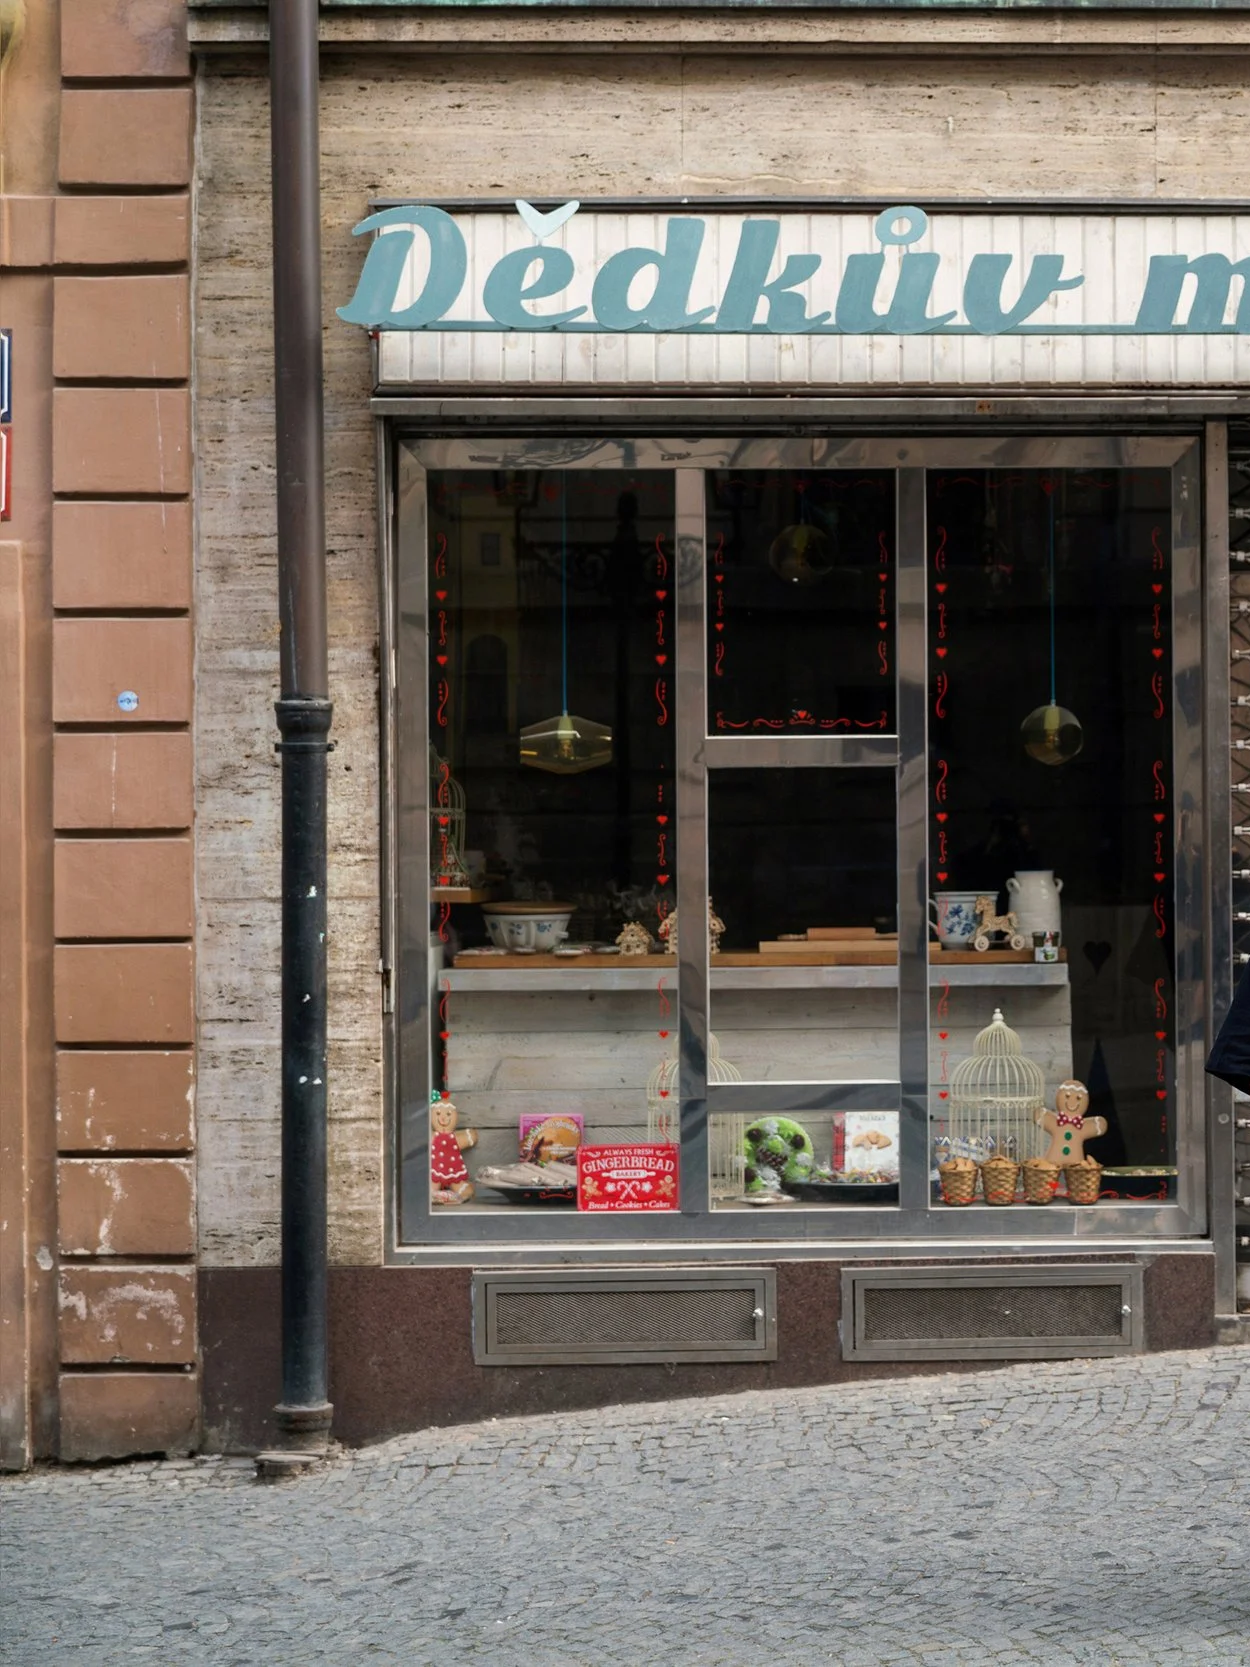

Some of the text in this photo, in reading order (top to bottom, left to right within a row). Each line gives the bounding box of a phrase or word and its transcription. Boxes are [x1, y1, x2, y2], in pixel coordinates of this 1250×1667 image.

[336, 199, 1085, 335] Dědkův
[582, 1156, 675, 1173] GINGERBREAD
[588, 1201, 609, 1209] Bread
[649, 1200, 671, 1208] Cakes
